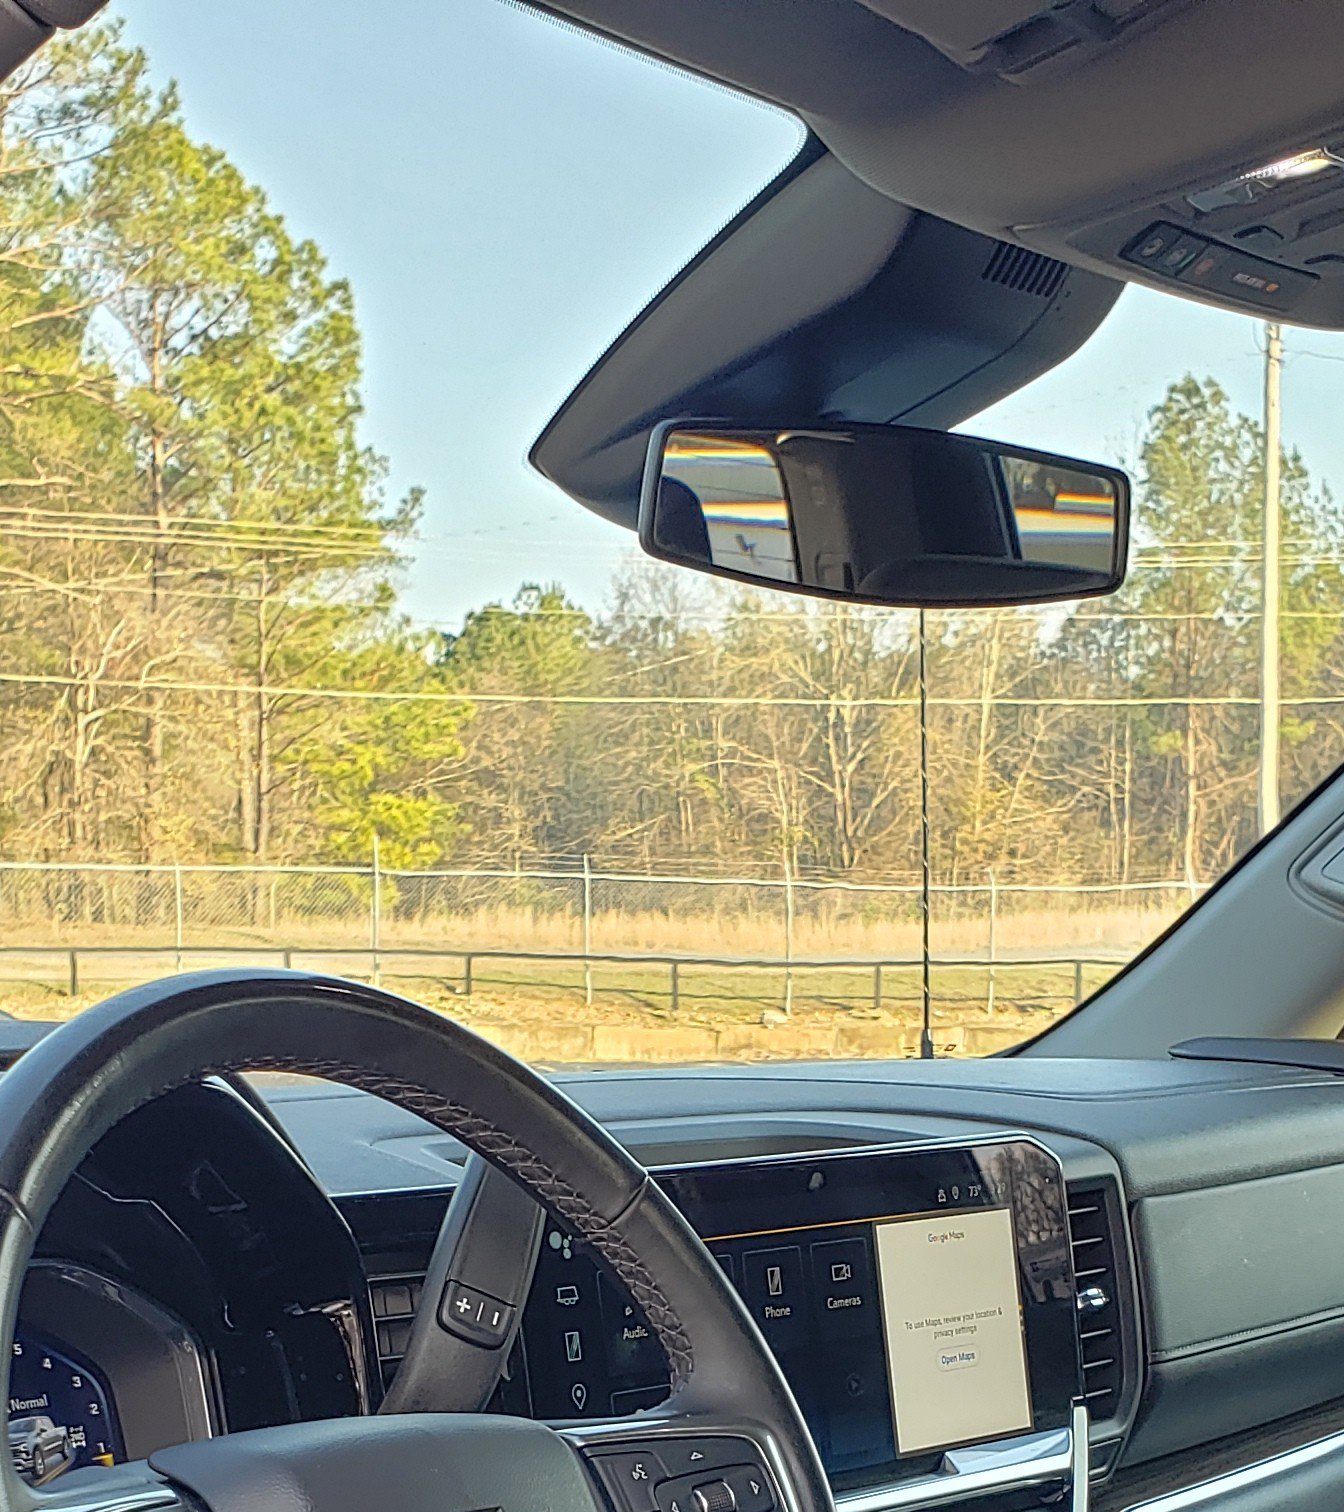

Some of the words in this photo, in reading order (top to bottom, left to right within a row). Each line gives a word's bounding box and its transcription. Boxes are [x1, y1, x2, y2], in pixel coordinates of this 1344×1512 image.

[927, 1233, 948, 1244] Google
[949, 1231, 965, 1241] Maps
[827, 1295, 862, 1310] Cameras
[764, 1304, 791, 1319] Phone
[943, 1313, 961, 1324] review
[962, 1311, 975, 1323] your
[975, 1307, 997, 1319] location
[933, 1327, 954, 1340] privacy
[954, 1324, 977, 1335] settings
[13, 1344, 23, 1355] 5
[42, 1358, 52, 1369] 4
[940, 1353, 958, 1365] Open
[958, 1351, 976, 1362] Maps
[71, 1376, 82, 1388] 3
[10, 1393, 49, 1412] Normal
[89, 1403, 100, 1415] 2
